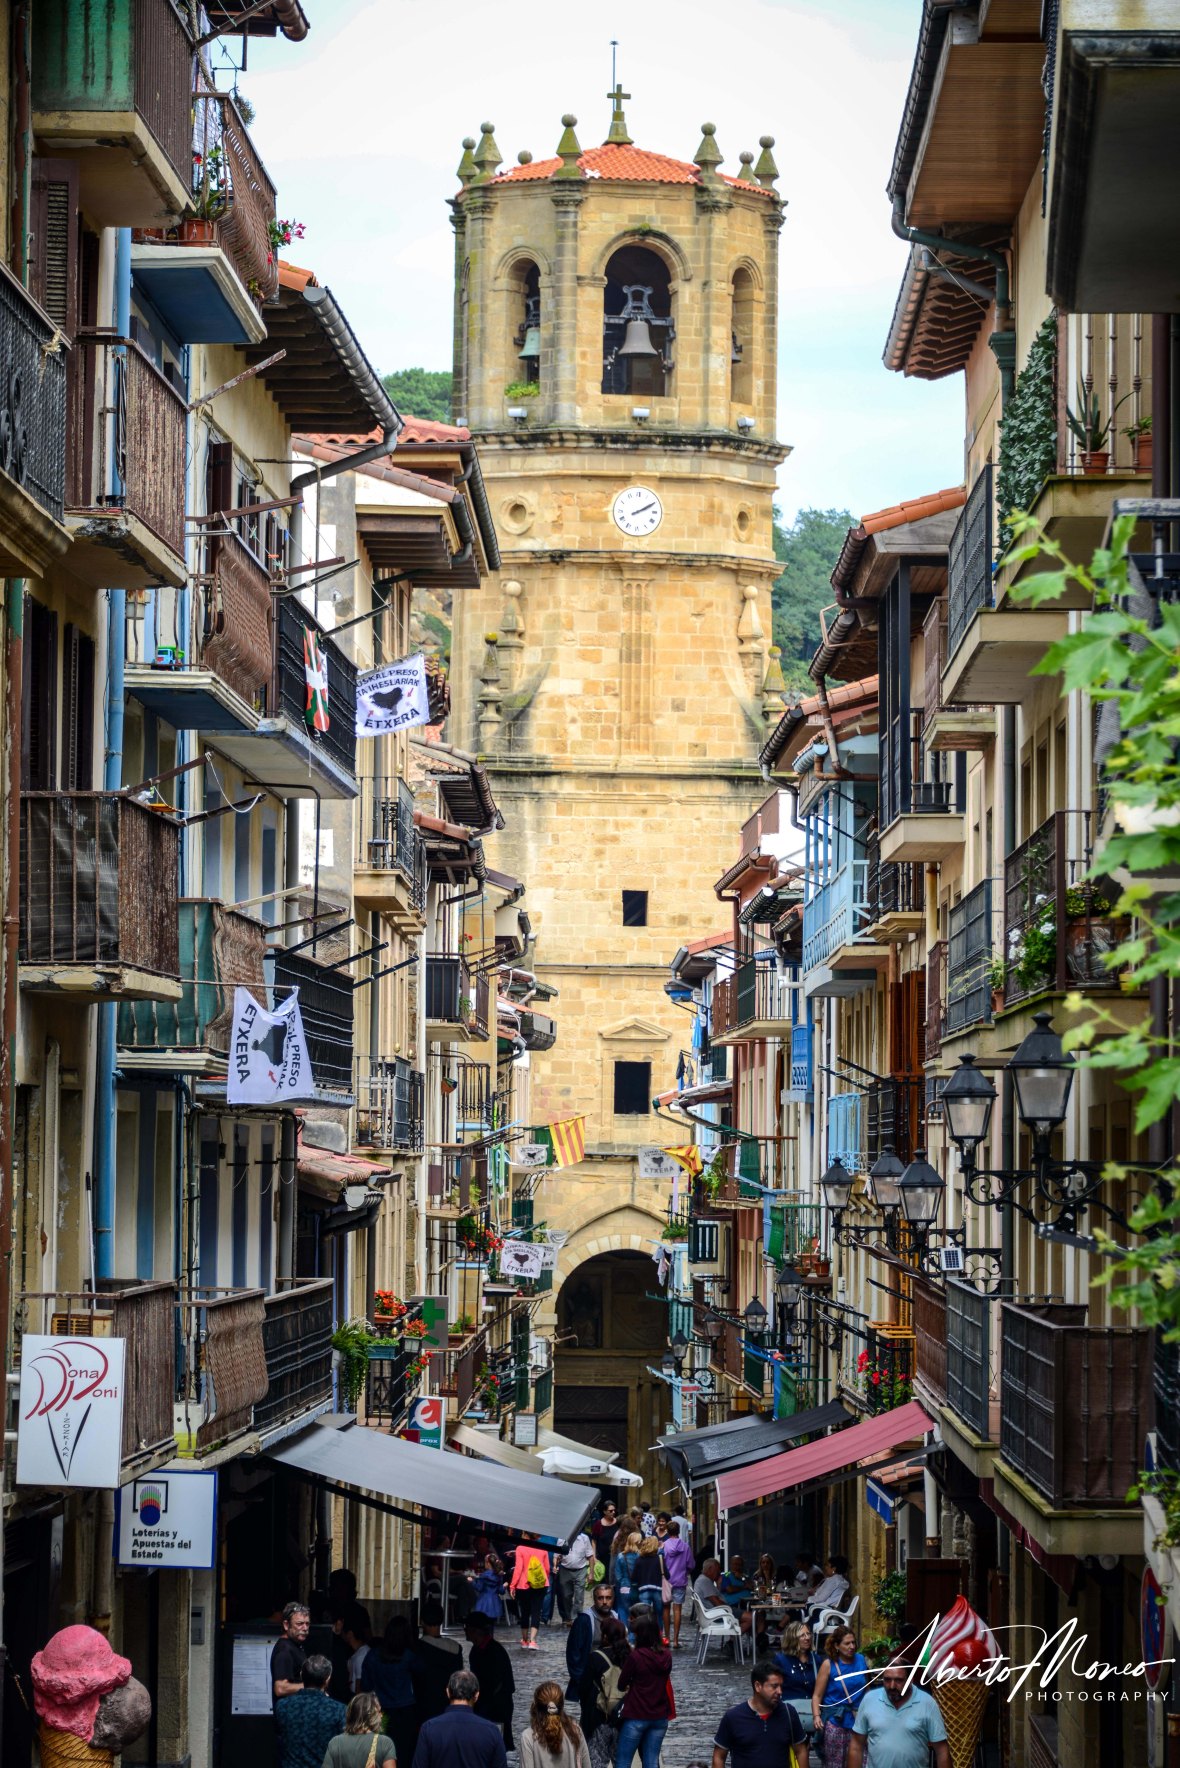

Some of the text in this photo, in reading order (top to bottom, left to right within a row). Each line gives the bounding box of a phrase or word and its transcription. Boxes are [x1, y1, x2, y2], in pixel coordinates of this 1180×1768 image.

[356, 669, 419, 688] USKAL PRESO
[364, 707, 420, 729] ETXERA
[235, 1003, 258, 1084] ETXERA
[288, 1044, 301, 1087] PRESO
[506, 1265, 534, 1273] ETXERA
[132, 1527, 178, 1539] Loterías y
[132, 1539, 191, 1549] Apuestas del
[131, 1549, 163, 1559] Estado
